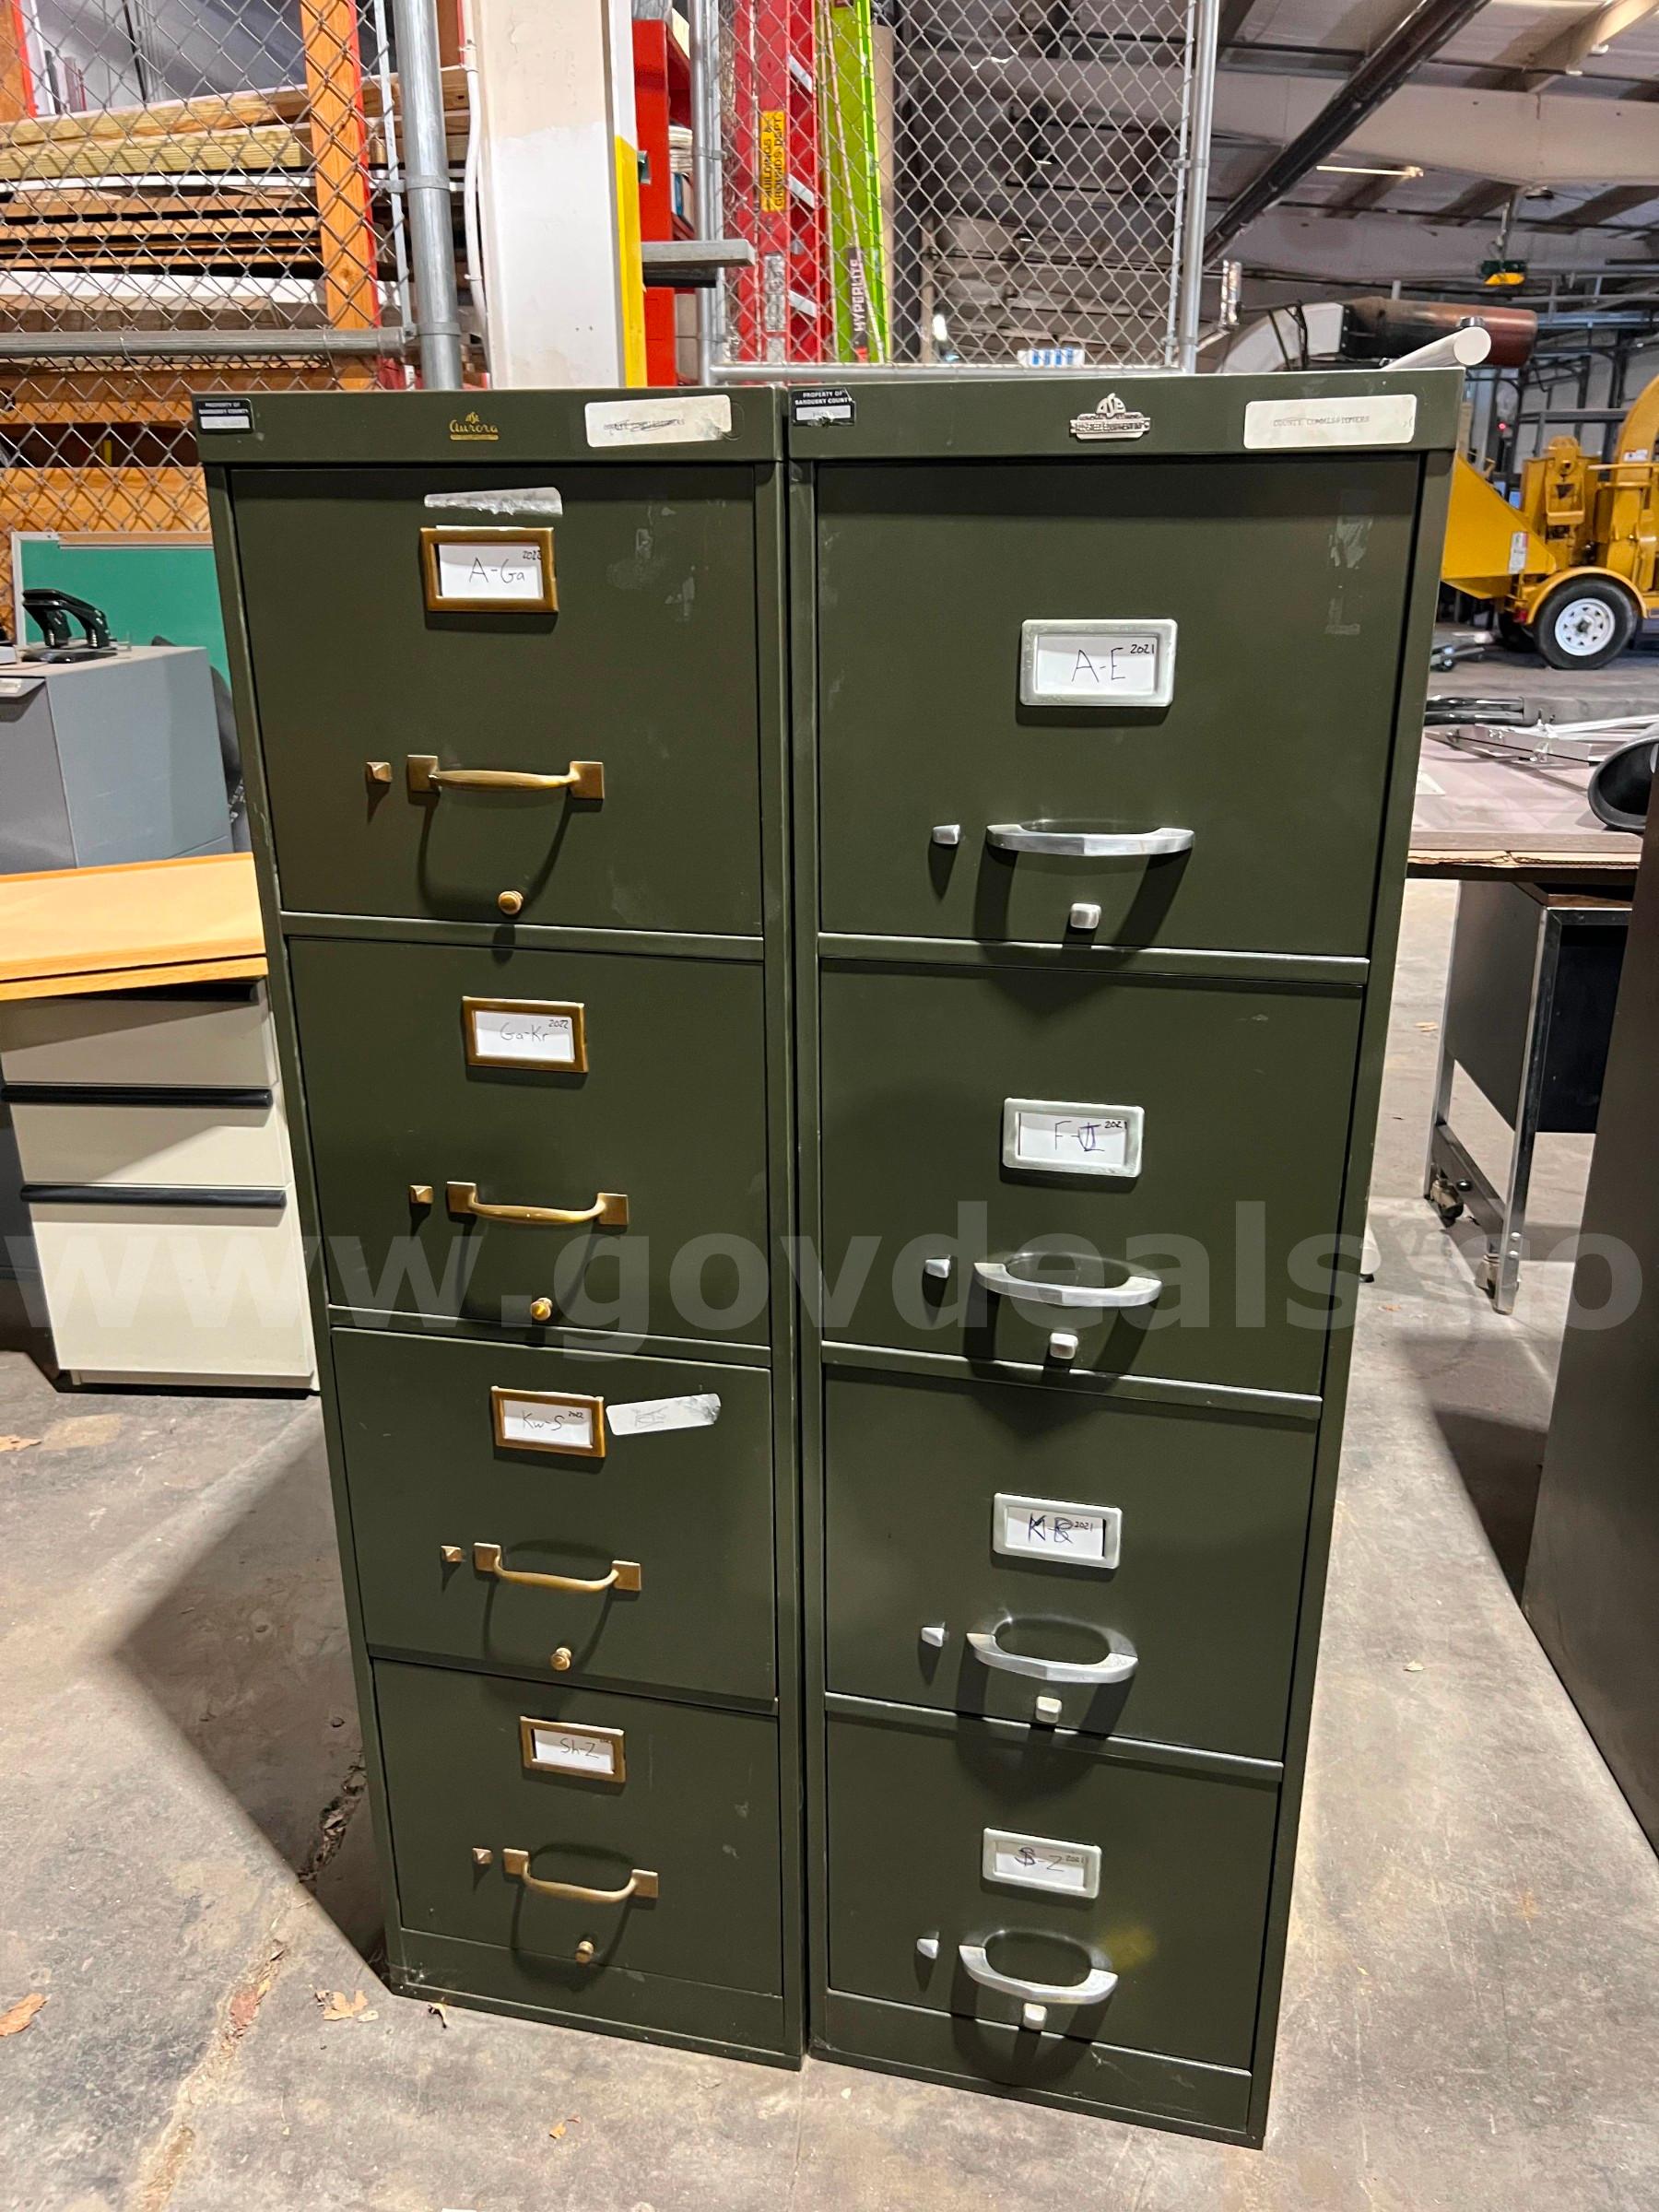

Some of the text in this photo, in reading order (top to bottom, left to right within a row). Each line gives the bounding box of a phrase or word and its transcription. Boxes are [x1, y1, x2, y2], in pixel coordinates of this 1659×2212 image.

[449, 419, 499, 433] Aurora
[1071, 643, 1156, 683] A-E 2021
[1104, 1120, 1128, 1130] 2021
[1073, 1521, 1094, 1533] 2021
